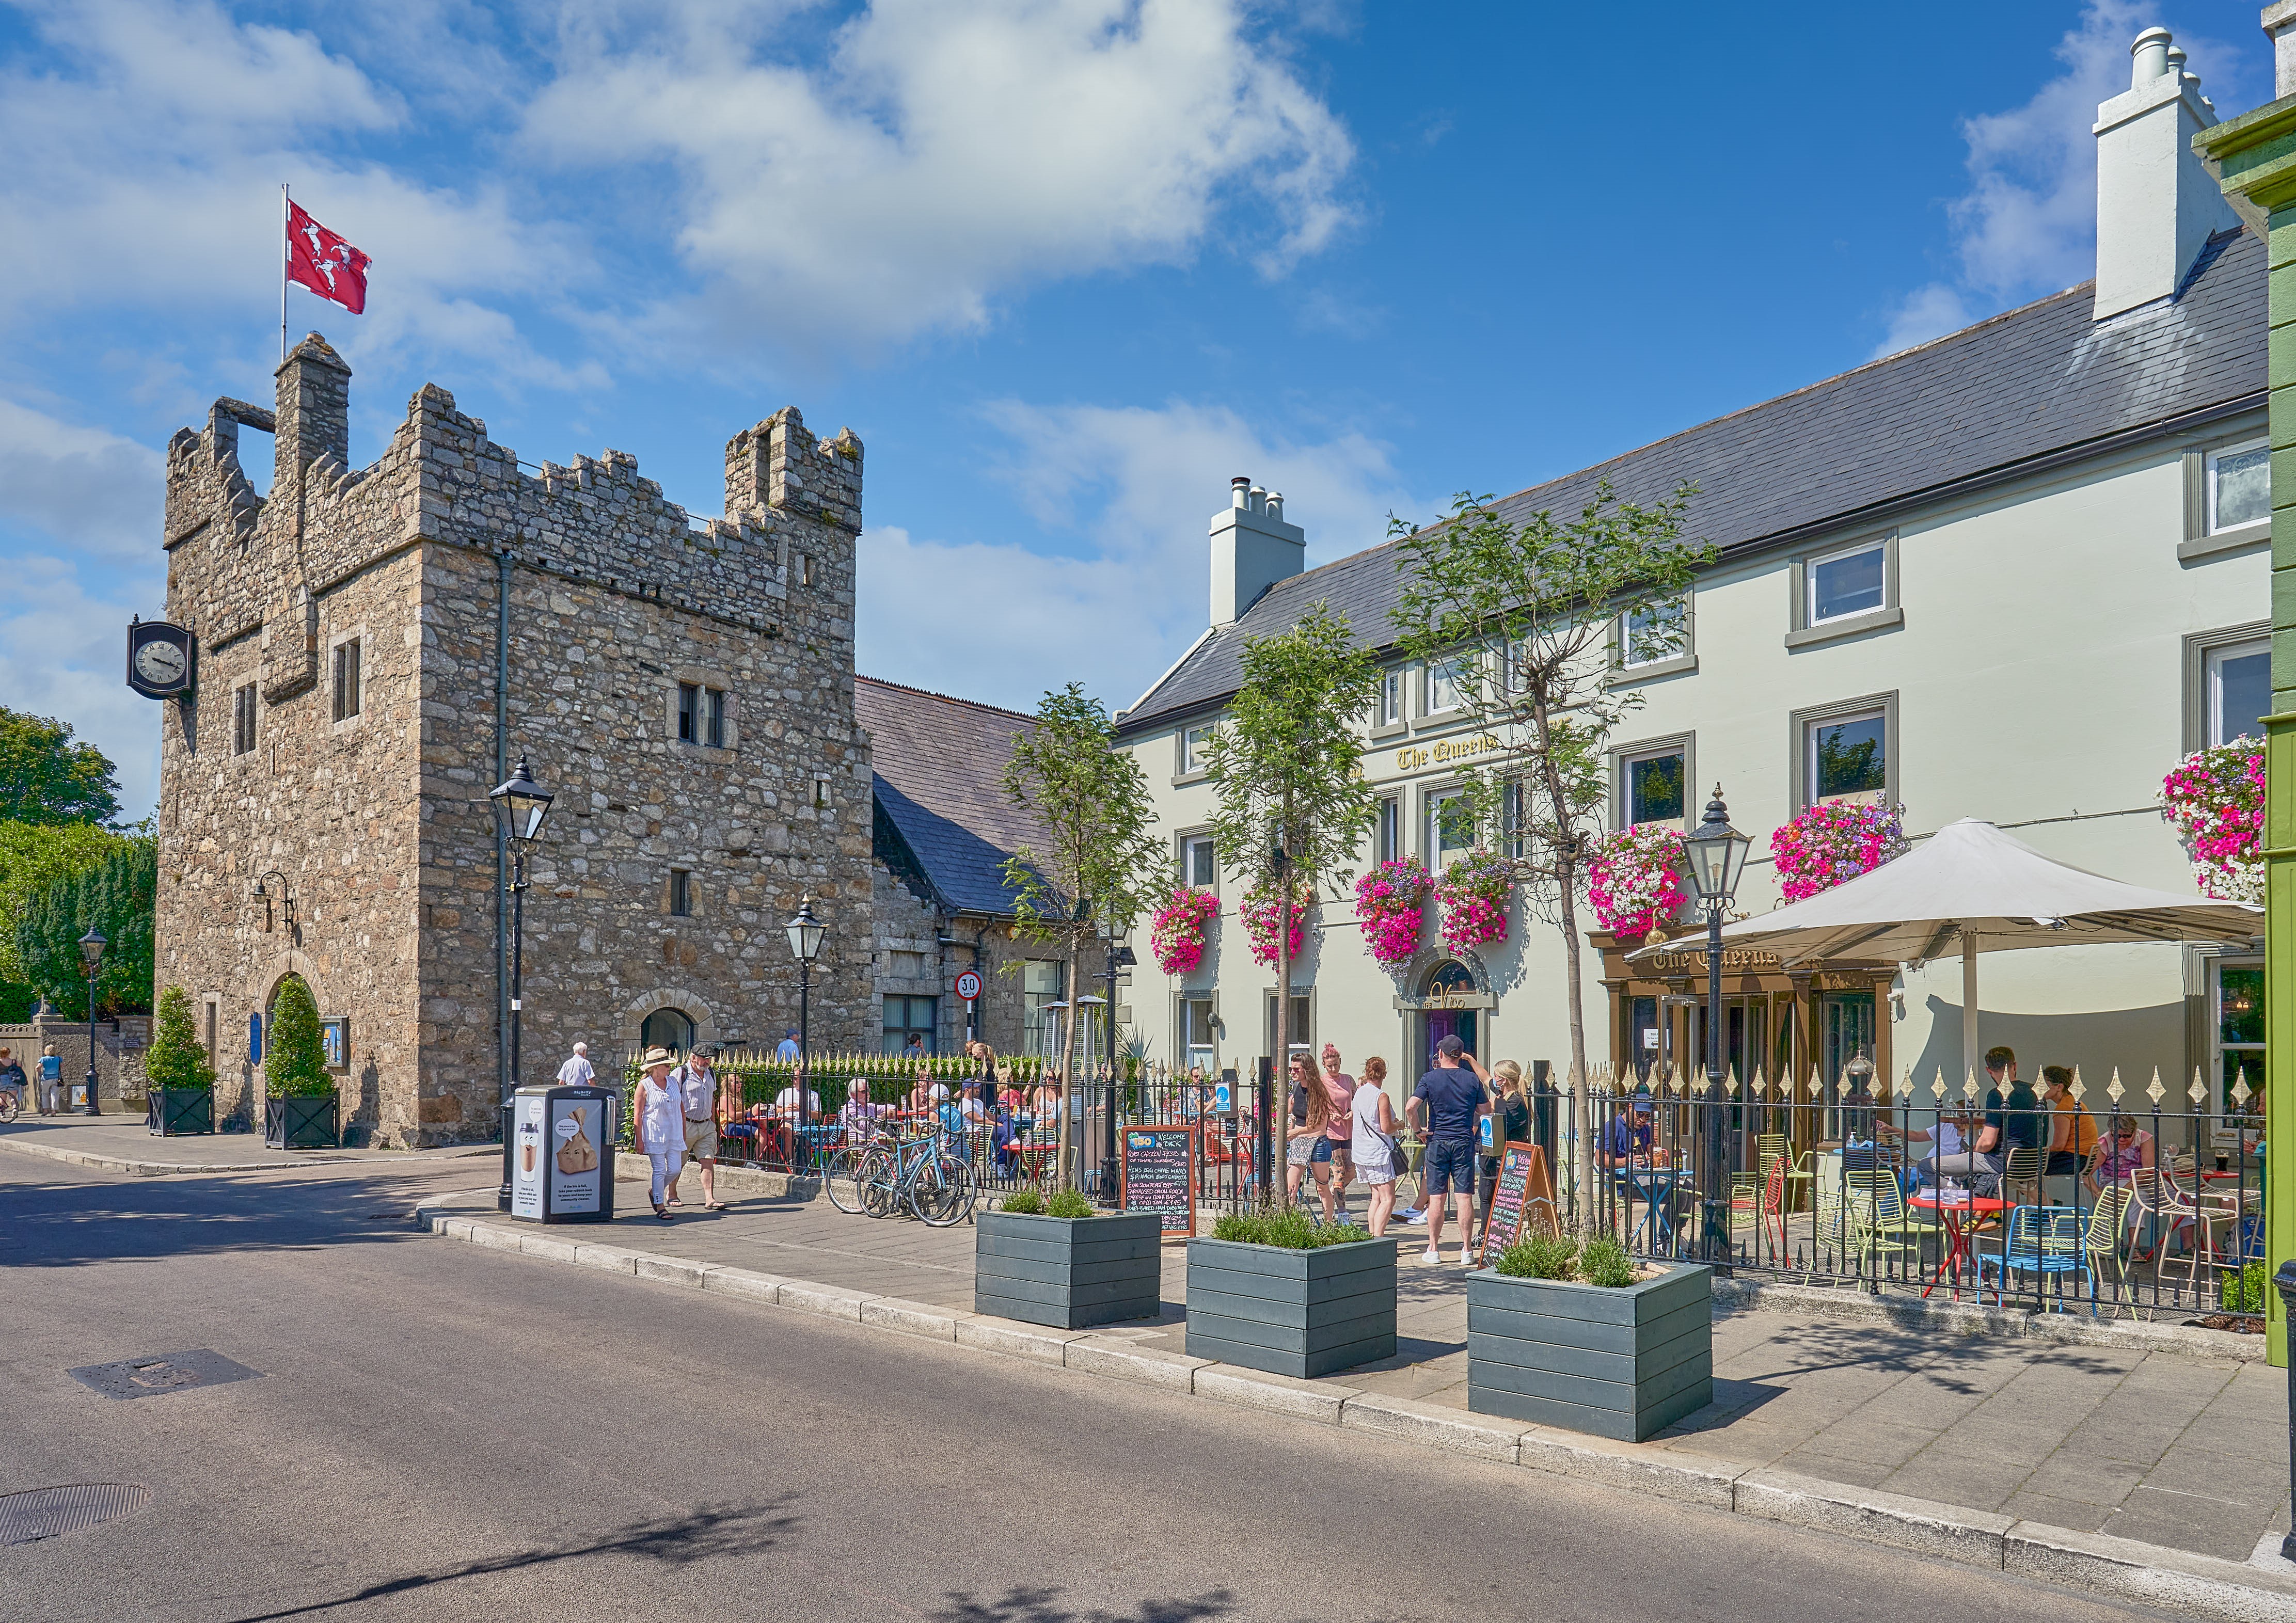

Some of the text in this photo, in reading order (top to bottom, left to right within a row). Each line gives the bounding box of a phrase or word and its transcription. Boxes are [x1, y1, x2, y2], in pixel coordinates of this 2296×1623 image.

[1396, 746, 1428, 770] The
[1653, 952, 1690, 970] The
[962, 978, 975, 991] 30
[1430, 981, 1465, 1009] Vico
[1134, 1138, 1152, 1146] 150
